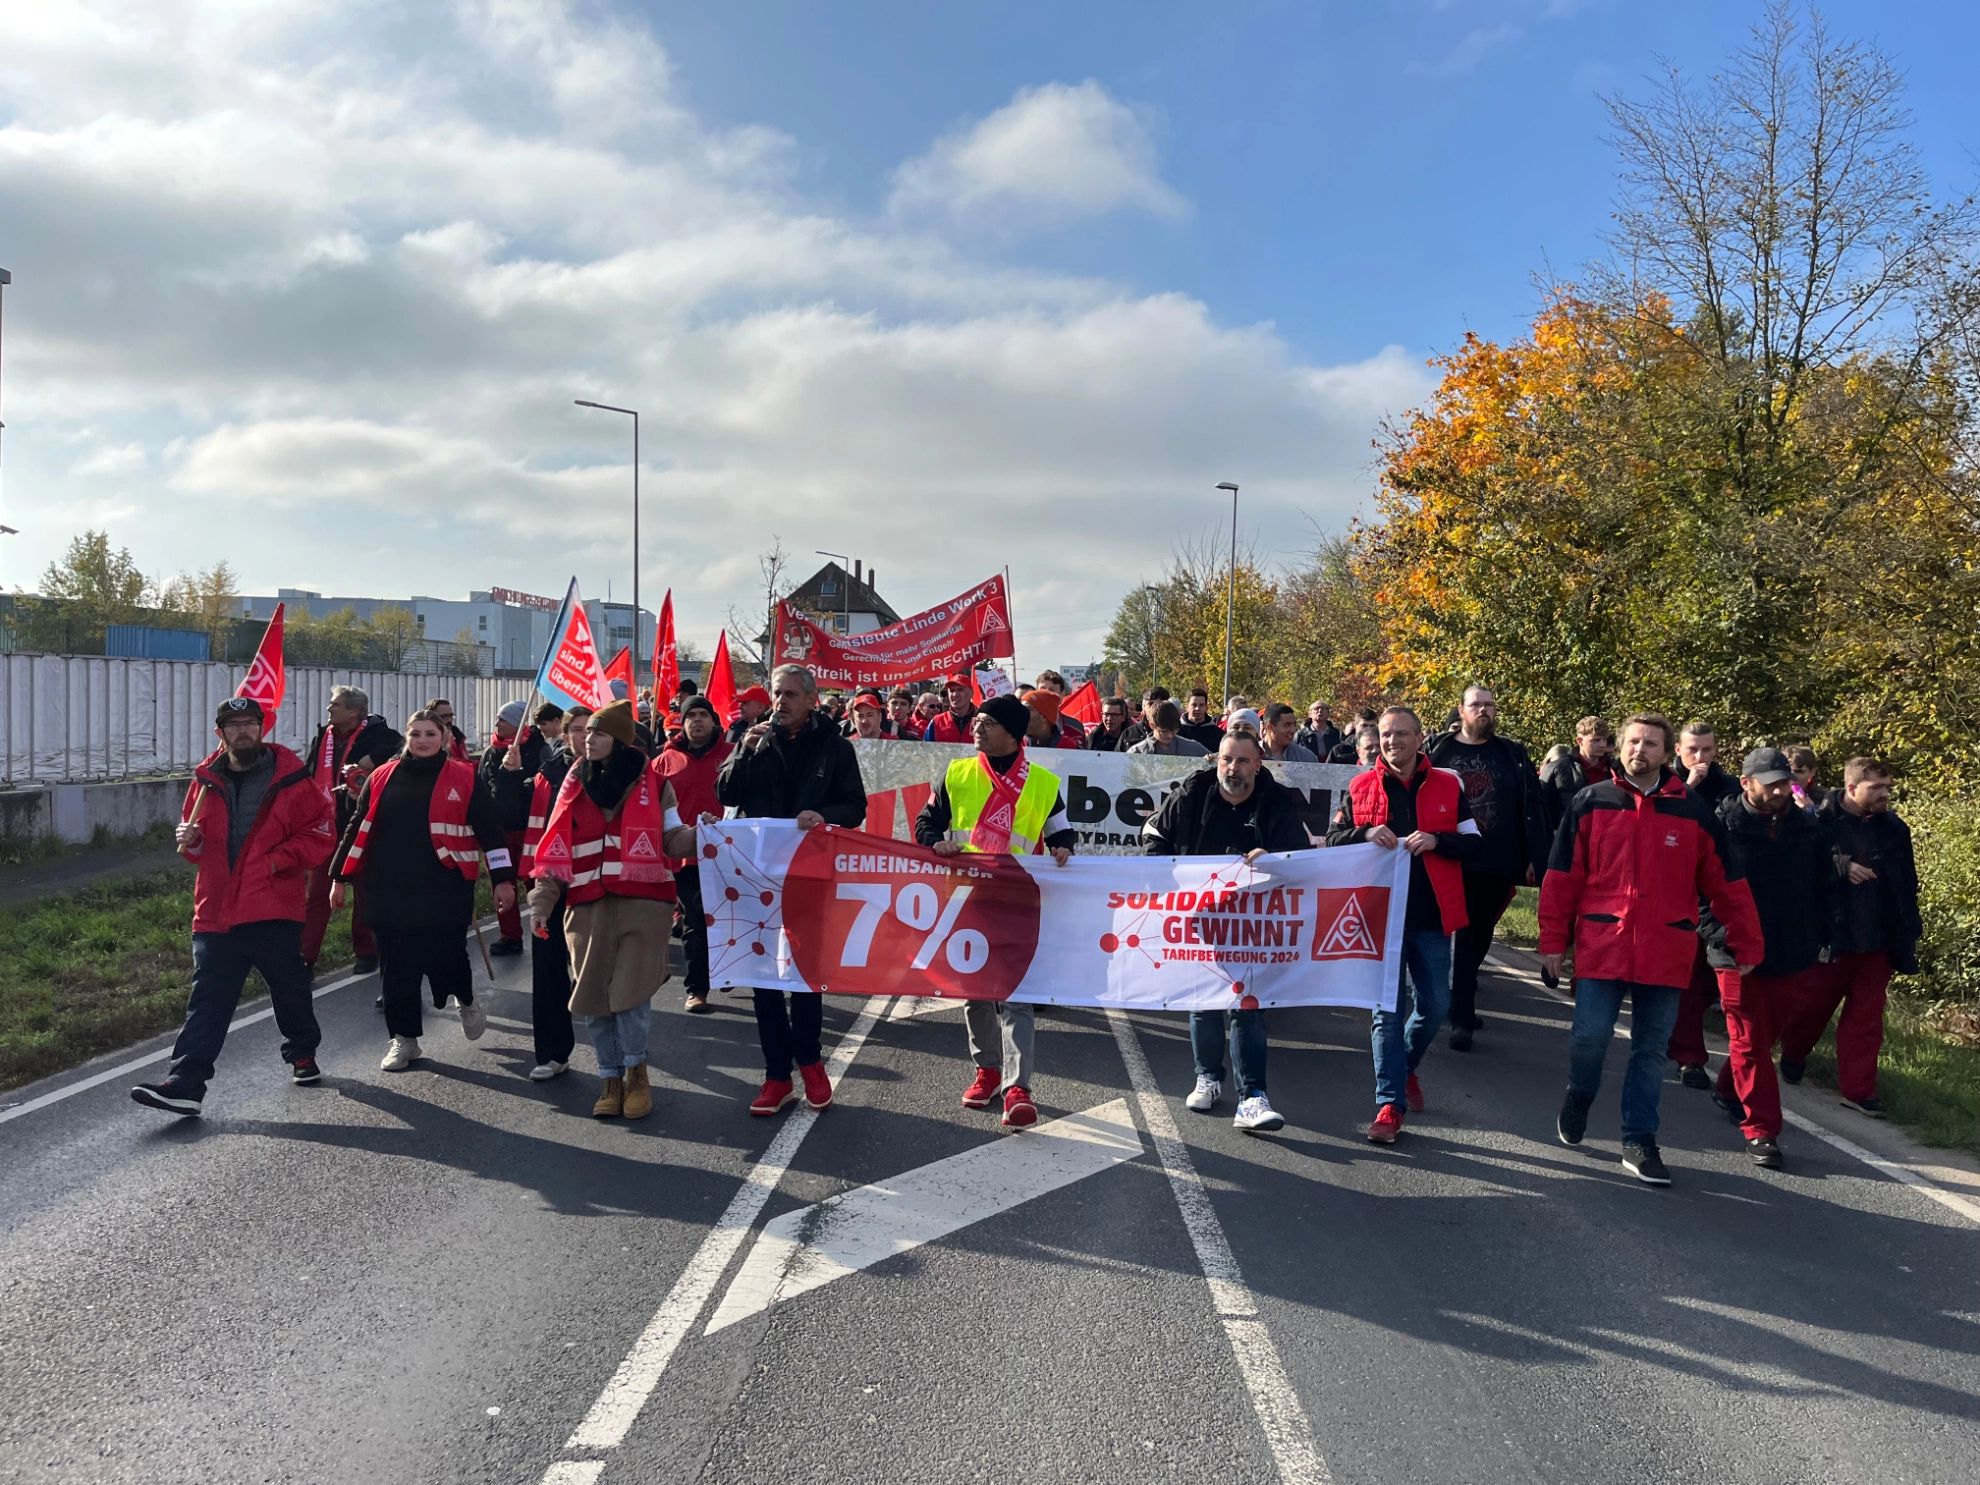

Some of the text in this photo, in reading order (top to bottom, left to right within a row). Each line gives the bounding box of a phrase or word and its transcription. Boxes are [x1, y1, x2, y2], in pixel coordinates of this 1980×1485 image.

[902, 611, 946, 634] Linde
[948, 589, 987, 614] Werk
[989, 581, 998, 595] 3
[560, 649, 586, 671] sind
[805, 640, 986, 682] Streik ist unser RECHT!
[896, 644, 919, 657] mehr
[904, 653, 921, 665] und
[834, 854, 993, 879] GEMEINSAM FÜR
[1106, 884, 1304, 915] SOLIDARITÄT
[835, 882, 990, 974] 7%
[1162, 915, 1304, 947] GEWINNT
[1162, 947, 1300, 964] TARIFBEWEGUNG 2024
